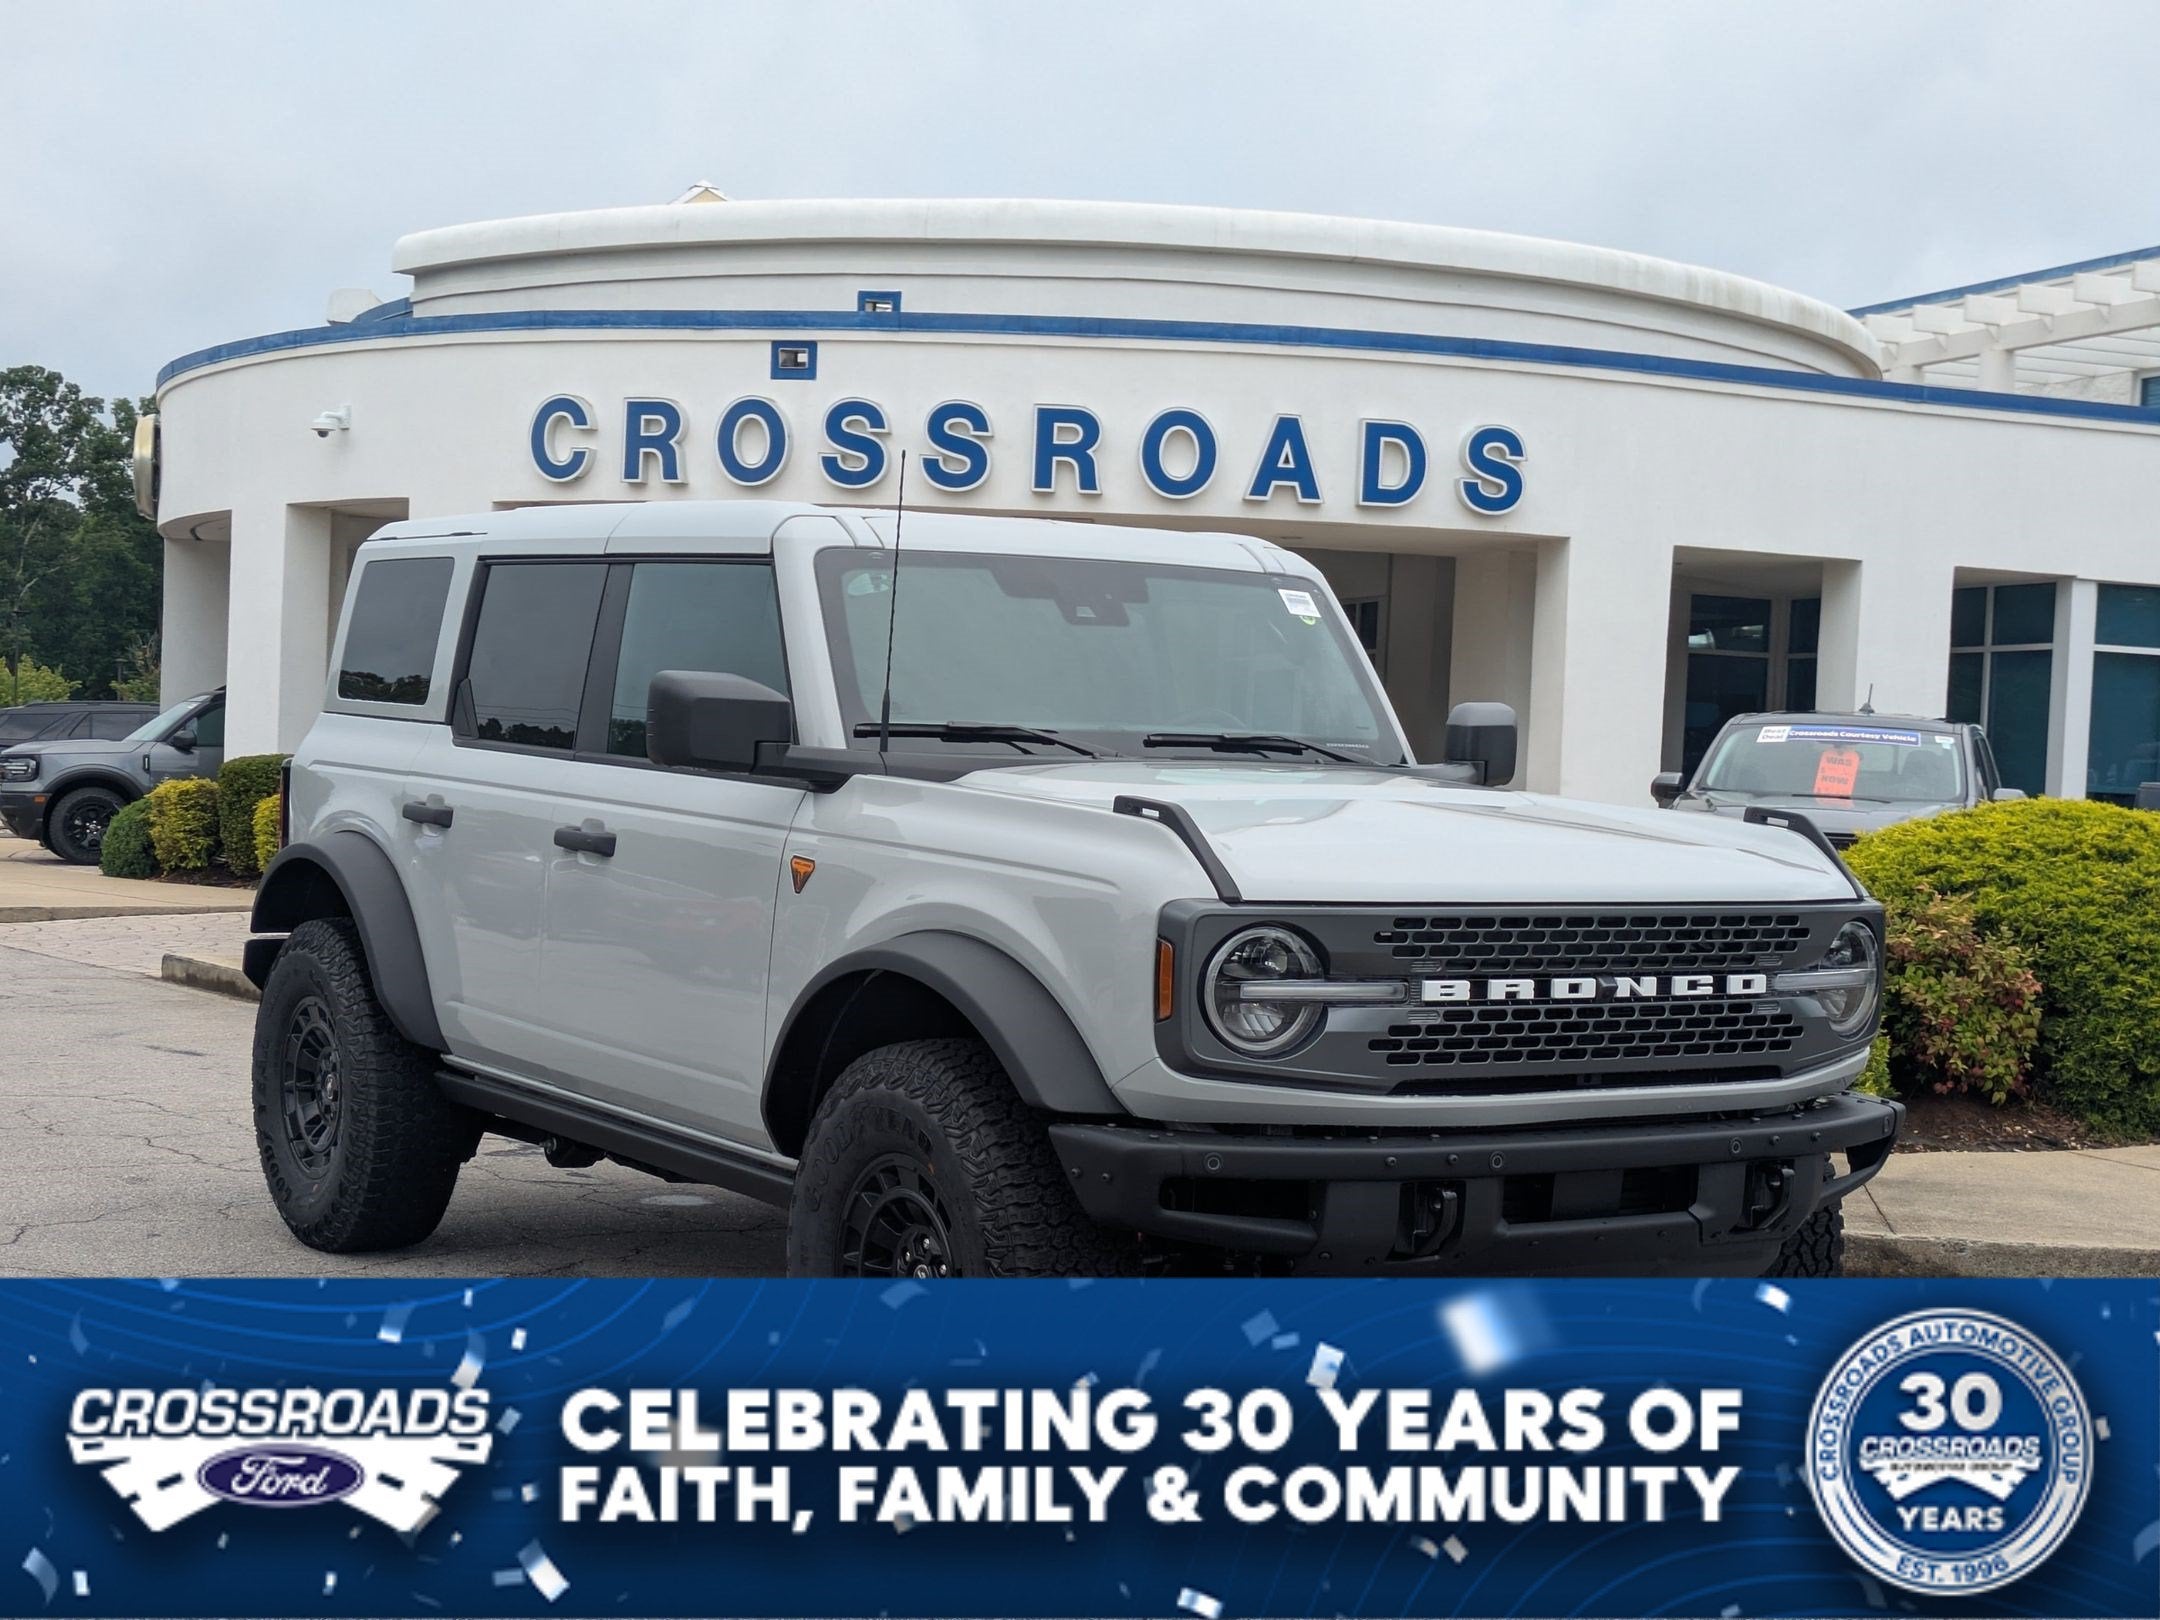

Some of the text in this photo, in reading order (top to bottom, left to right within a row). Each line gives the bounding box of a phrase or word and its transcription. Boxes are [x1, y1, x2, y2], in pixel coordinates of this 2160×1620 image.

[529, 394, 1528, 516] CROSSROADS
[1788, 730, 1918, 742] Crossroads Courtesy Vehicle
[1422, 973, 1768, 1001] BRONCO
